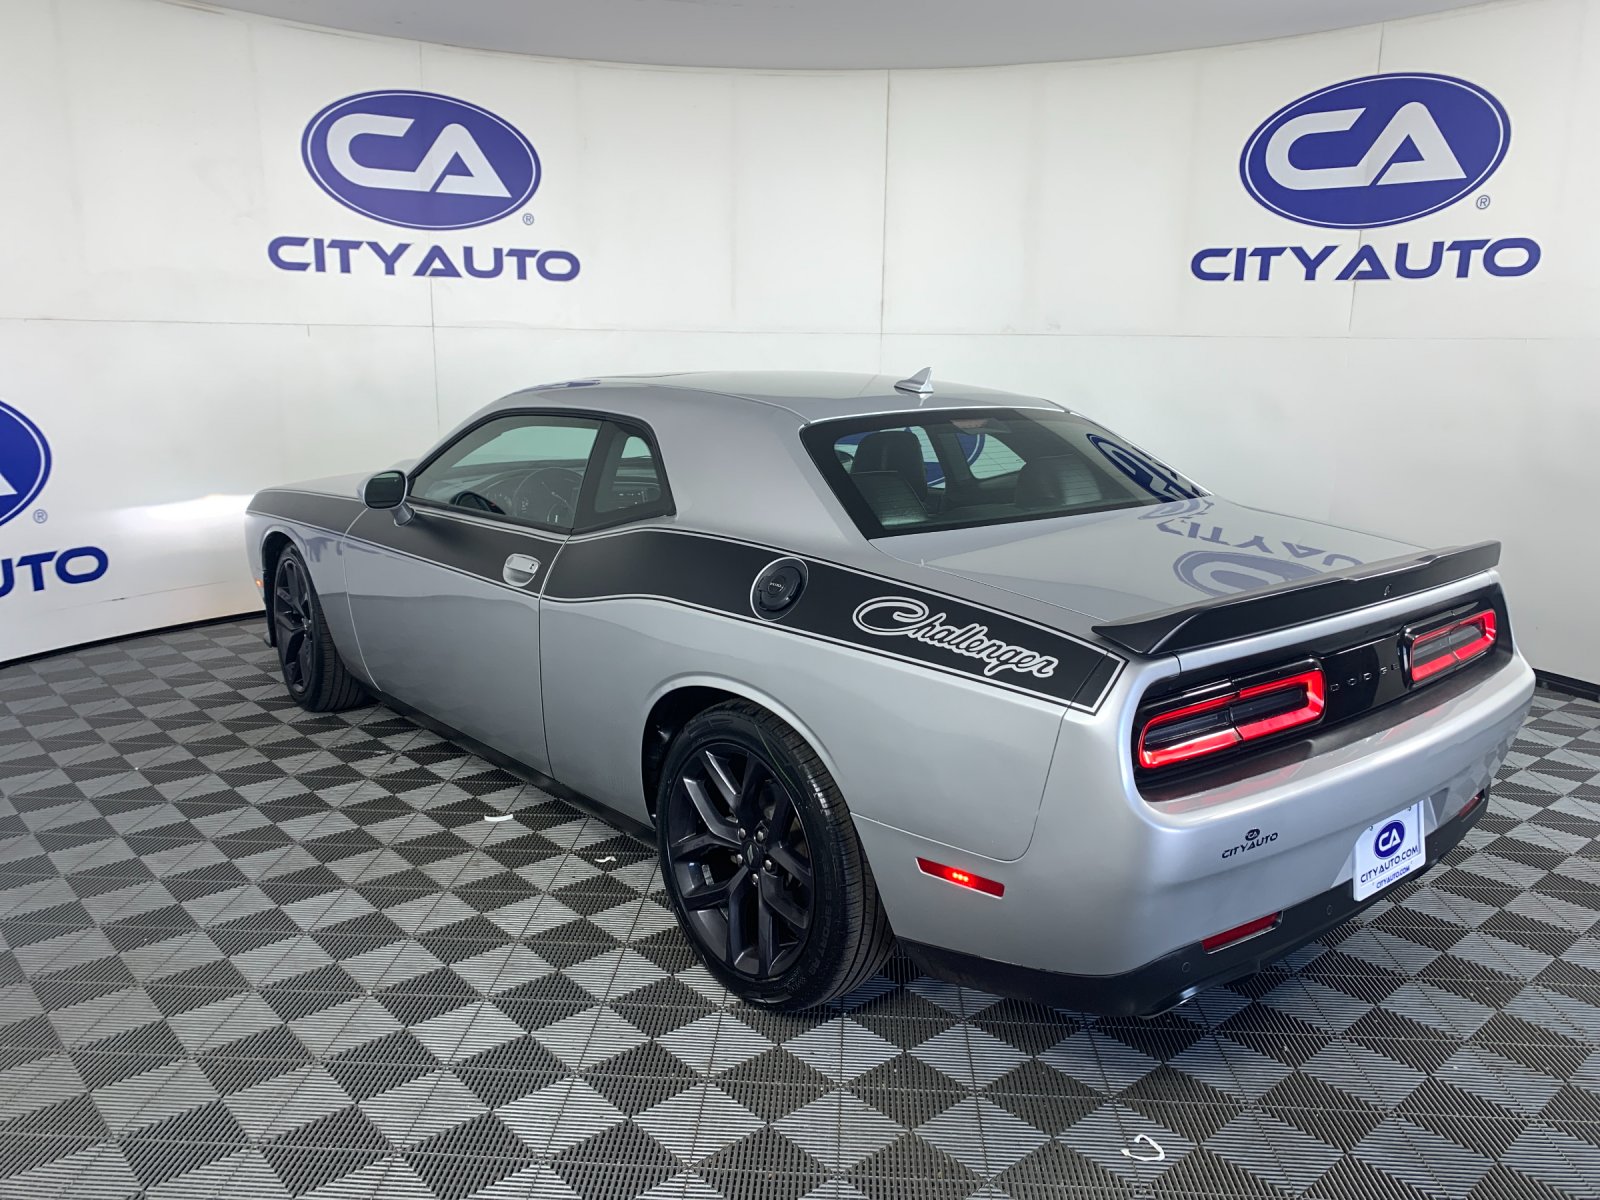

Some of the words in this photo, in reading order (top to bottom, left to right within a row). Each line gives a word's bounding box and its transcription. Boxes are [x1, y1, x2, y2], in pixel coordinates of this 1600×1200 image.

[326, 113, 512, 198] CA
[1265, 101, 1468, 191] CA
[852, 596, 1058, 677] Challenger
[1360, 845, 1418, 883] CITYAUTO.COM
[1379, 828, 1402, 852] CA
[1376, 865, 1410, 889] CITYAUTO.COM
